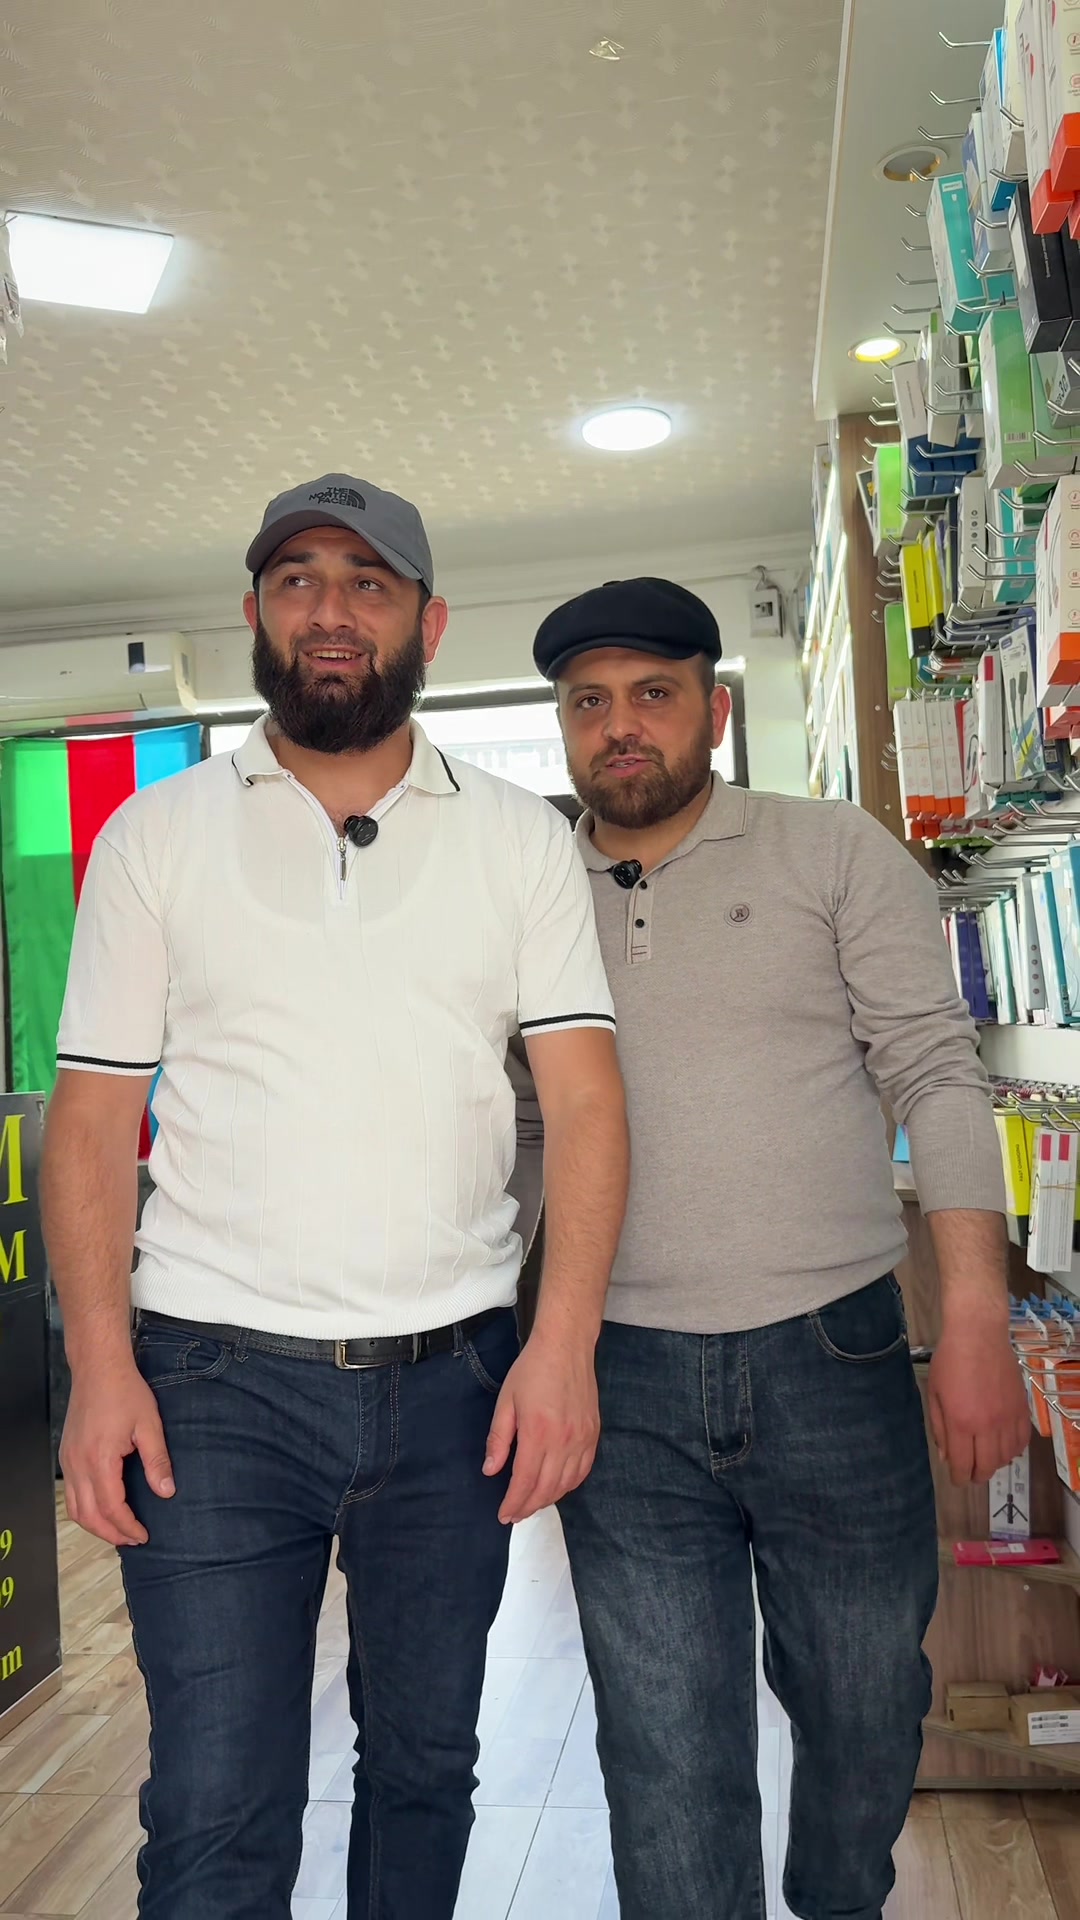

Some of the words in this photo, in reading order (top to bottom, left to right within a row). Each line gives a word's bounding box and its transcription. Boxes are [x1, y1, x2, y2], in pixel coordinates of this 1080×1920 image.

[326, 486, 349, 494] THE
[308, 491, 348, 501] NORTH
[317, 498, 346, 506] FACE
